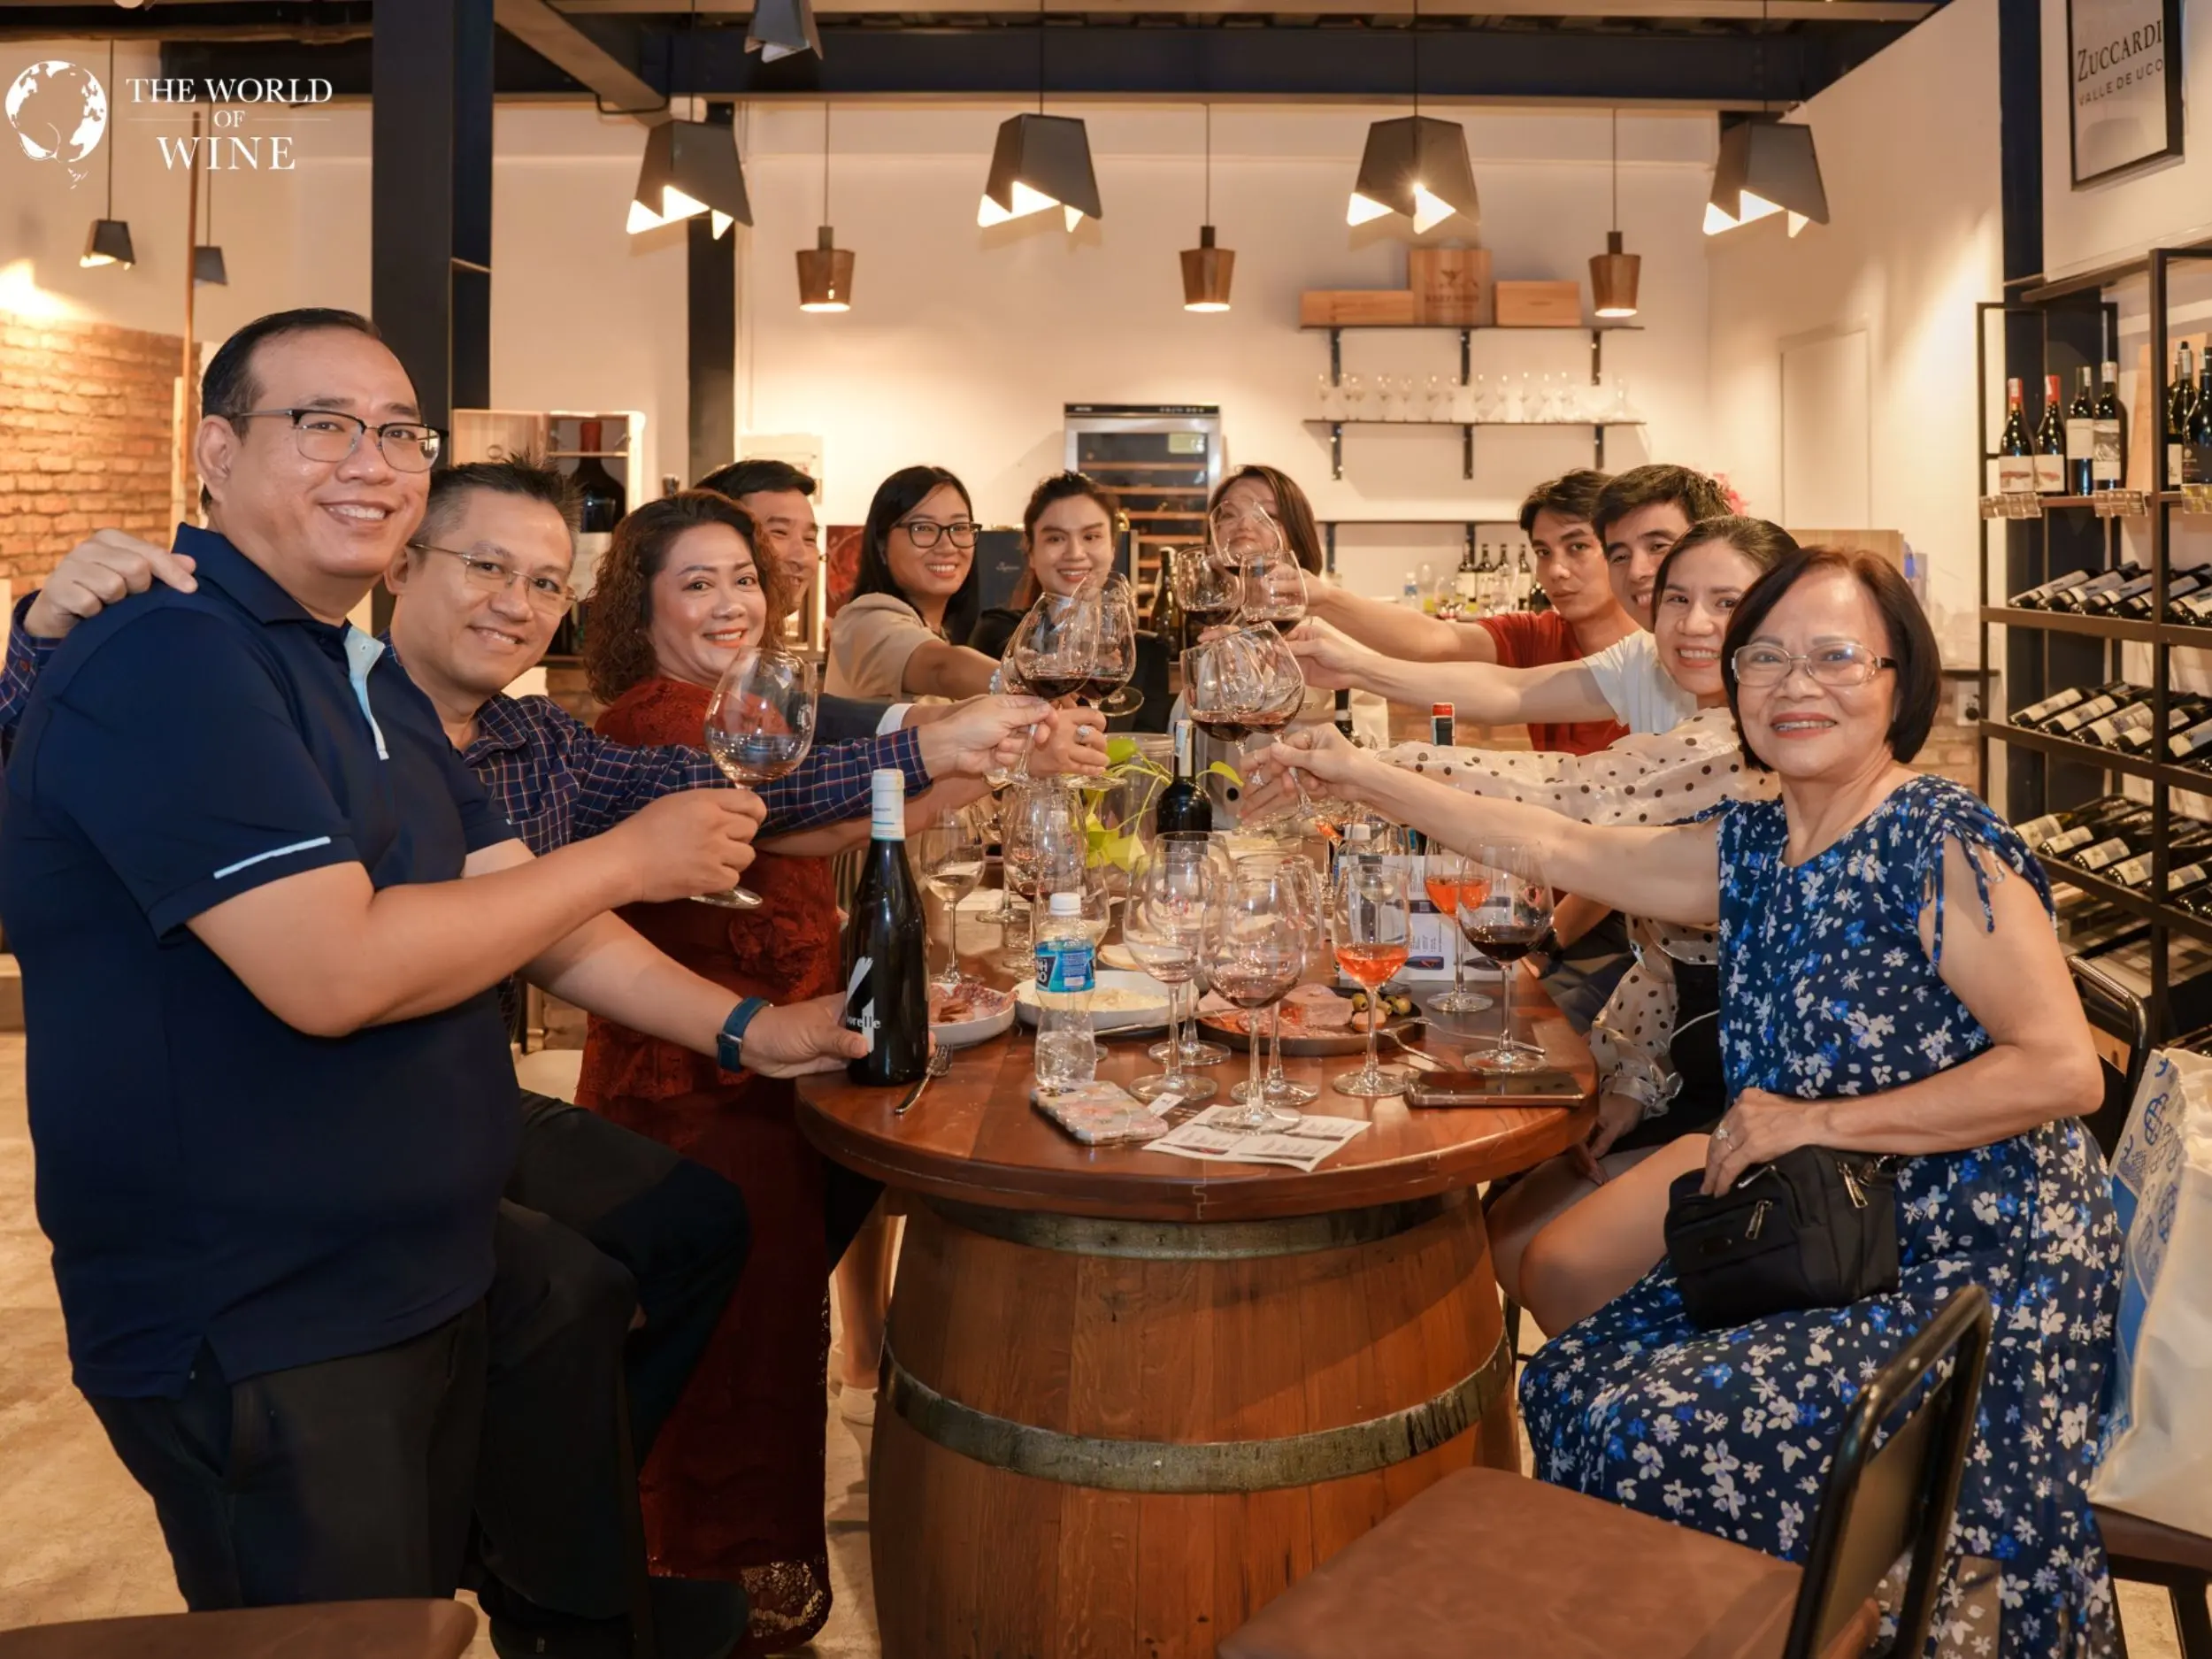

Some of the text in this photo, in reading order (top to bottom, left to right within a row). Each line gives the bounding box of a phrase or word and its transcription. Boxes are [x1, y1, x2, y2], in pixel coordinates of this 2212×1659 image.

[2078, 19, 2162, 82] ZUCCARDI
[2078, 58, 2163, 106] VALLE DE UCO
